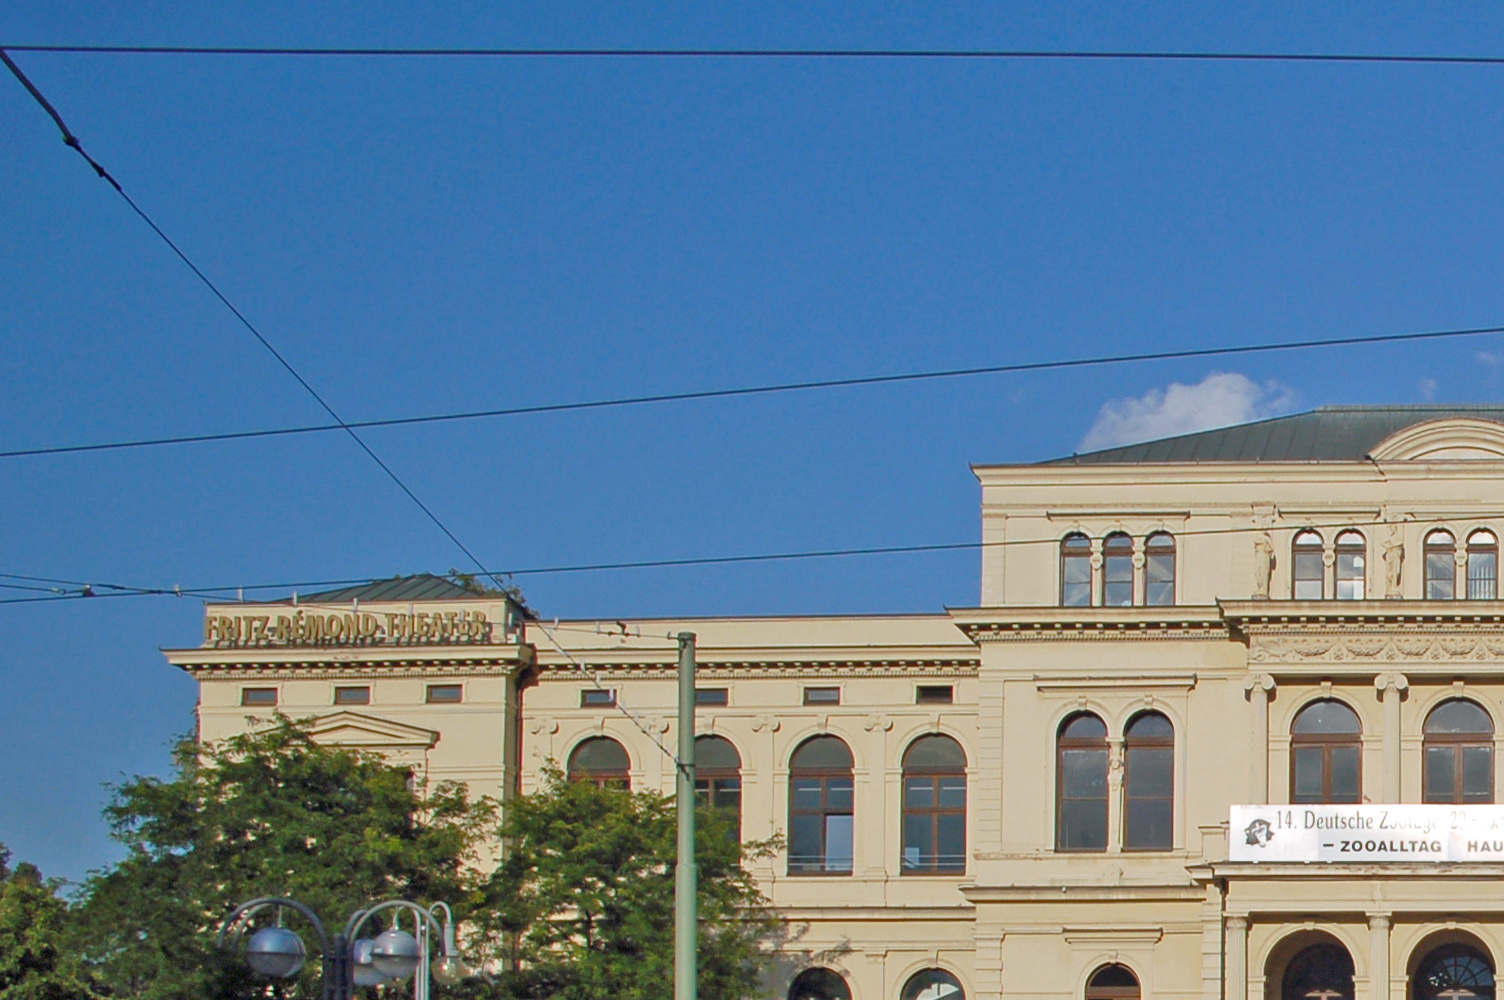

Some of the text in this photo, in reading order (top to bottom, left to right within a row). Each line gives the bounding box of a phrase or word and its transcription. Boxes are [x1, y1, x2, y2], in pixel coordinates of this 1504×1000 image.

[205, 610, 487, 640] FRITZ RÉMOND THEATER
[1276, 810, 1297, 829] 14.
[1304, 810, 1374, 829] Deutsche
[1339, 840, 1442, 853] ZOOALLTAG
